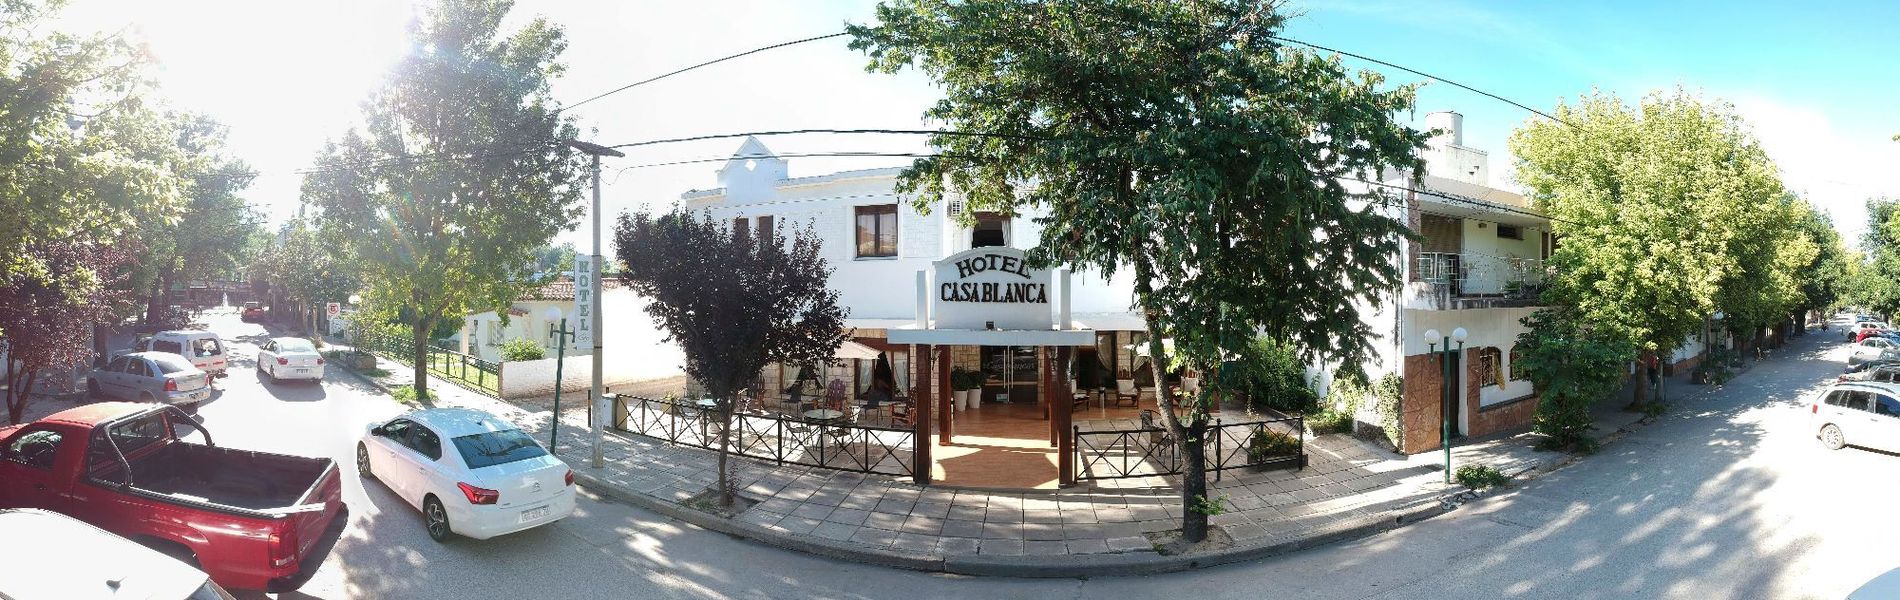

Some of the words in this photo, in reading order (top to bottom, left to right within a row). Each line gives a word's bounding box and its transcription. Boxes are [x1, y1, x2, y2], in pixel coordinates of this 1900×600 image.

[955, 253, 1031, 279] HOTEL
[578, 261, 590, 331] HOTEL
[940, 282, 1047, 304] CASABLANCA
